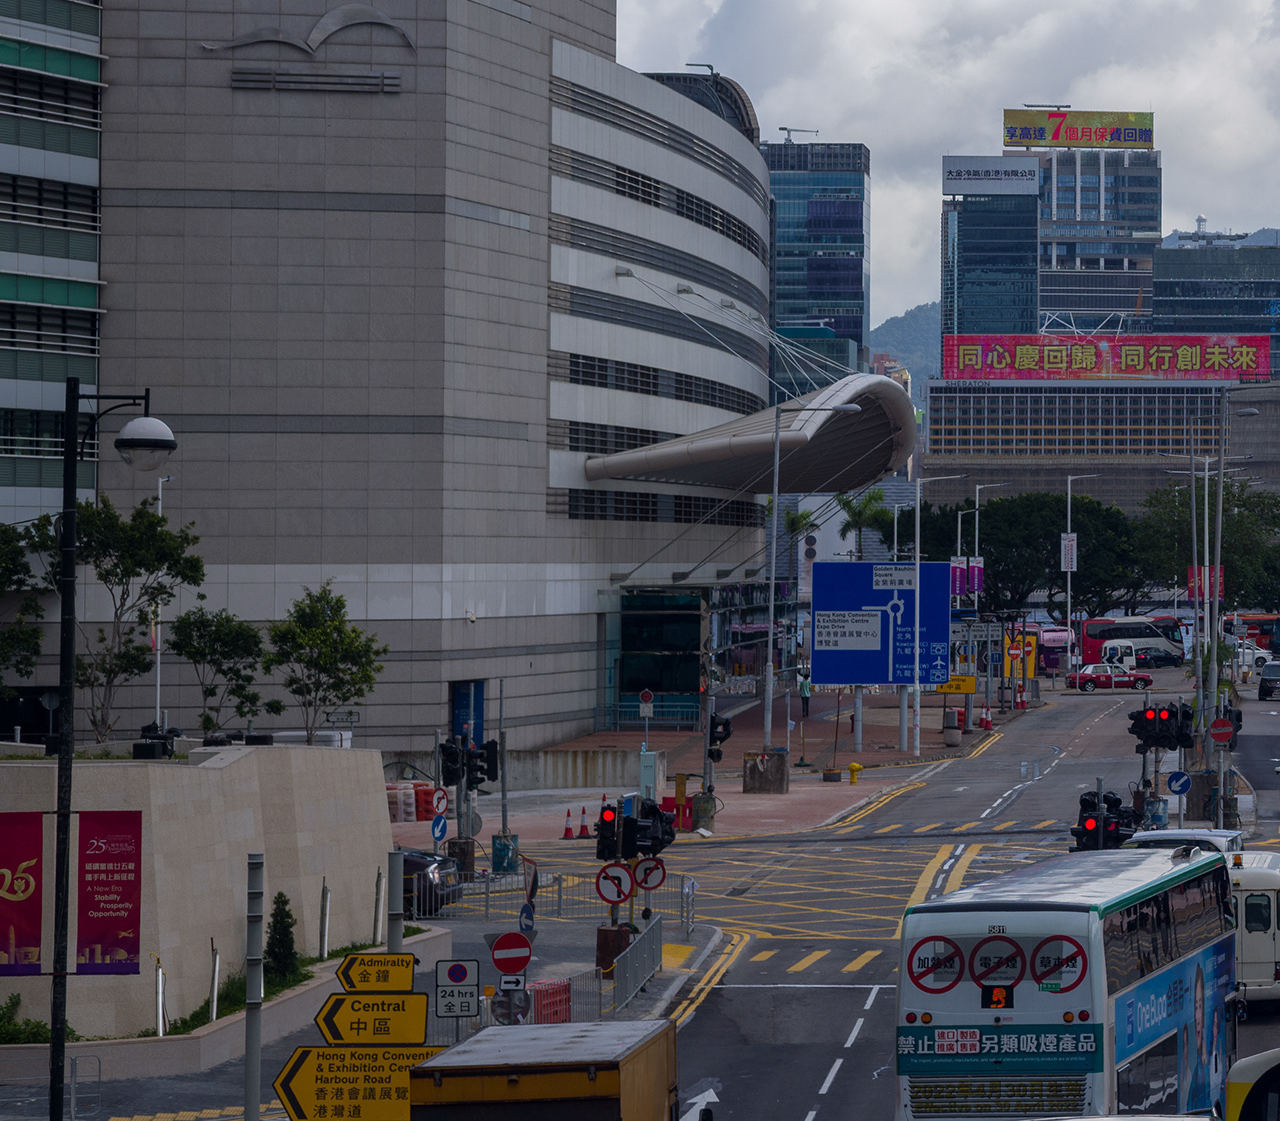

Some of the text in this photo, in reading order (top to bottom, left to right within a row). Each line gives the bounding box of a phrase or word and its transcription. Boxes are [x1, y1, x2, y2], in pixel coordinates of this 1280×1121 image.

[957, 344, 1258, 371] 同心慶回歸 同行創未來
[945, 380, 991, 388] SHERATON
[817, 630, 878, 638] 香港會議展覽中心
[86, 839, 107, 854] 25
[100, 902, 133, 910] Prosperity
[88, 910, 128, 918] Opportunity
[988, 925, 1007, 933] 5811
[358, 958, 411, 969] Admiralty
[358, 969, 390, 983] 金鐘
[440, 989, 474, 998] 24 hrs
[351, 999, 406, 1012] Central
[443, 1001, 470, 1013] 全日
[350, 1018, 391, 1036] 中區
[937, 1030, 978, 1040] 進口 製造
[897, 1033, 1096, 1053] 禁止 另類吸煙產品
[937, 1042, 978, 1052] 推廣 售賣
[316, 1051, 437, 1062] Hong Kong Conventi
[316, 1063, 324, 1072] &
[328, 1063, 386, 1073] Exhibition
[315, 1075, 391, 1084] Harbour Road
[911, 1080, 1083, 1099] 2022年4月30日生效
[313, 1104, 362, 1118] 港灣道
[914, 1100, 1079, 1114] Effective on 30 April 2022
